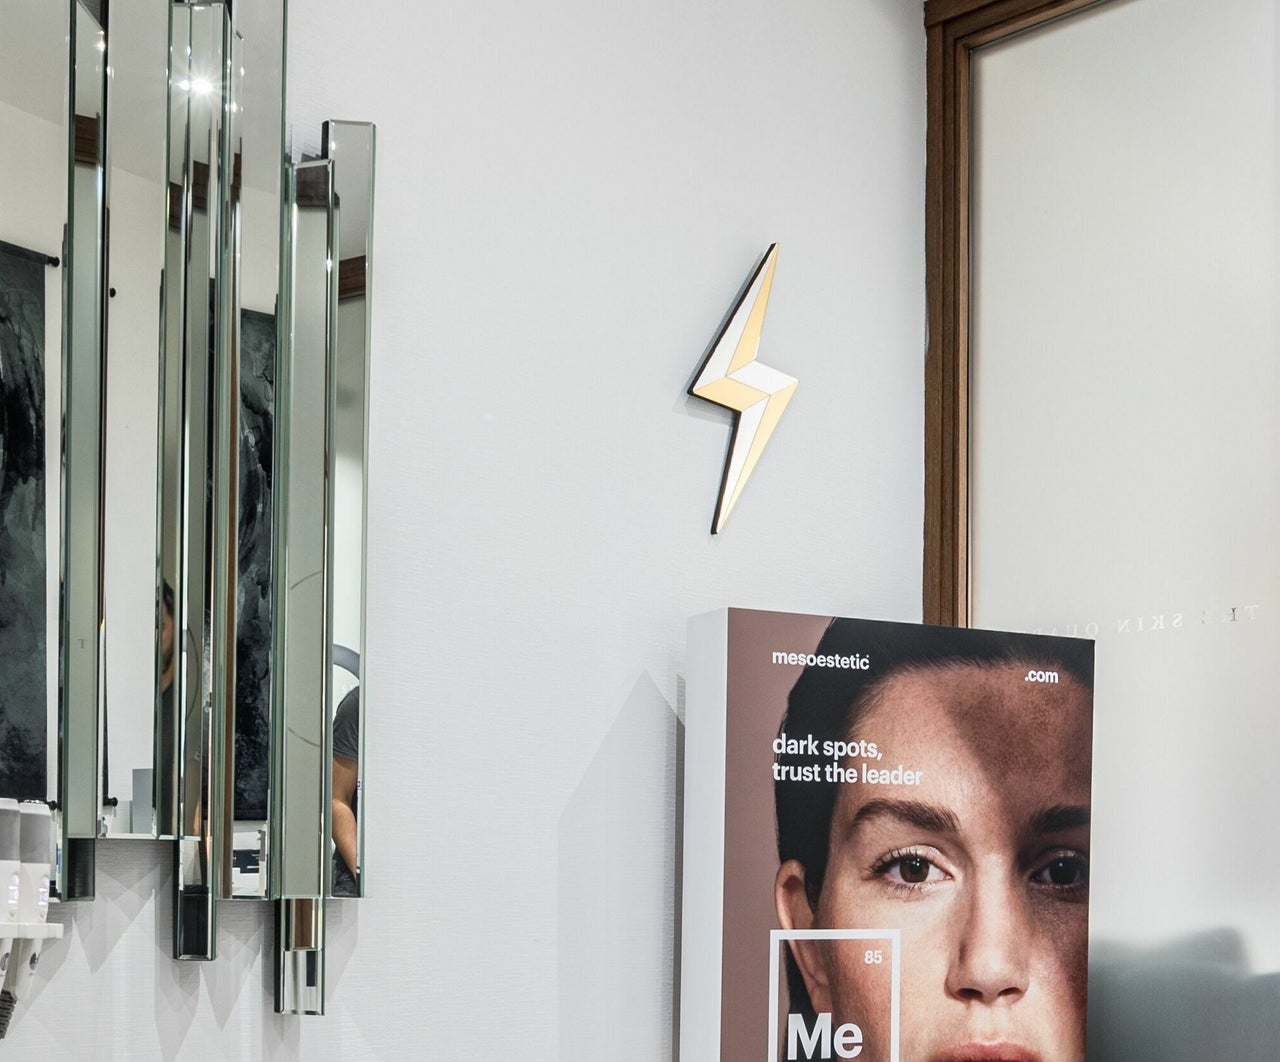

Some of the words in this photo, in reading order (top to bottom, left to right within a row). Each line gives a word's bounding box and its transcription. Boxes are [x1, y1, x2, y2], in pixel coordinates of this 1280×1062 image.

[1024, 668, 1059, 684] .com
[772, 732, 820, 755] dark
[822, 739, 883, 761] spots,
[772, 762, 821, 782] trust
[824, 762, 858, 784] the
[861, 763, 924, 785] leader
[863, 950, 883, 965] 85
[787, 1012, 864, 1061] Me
